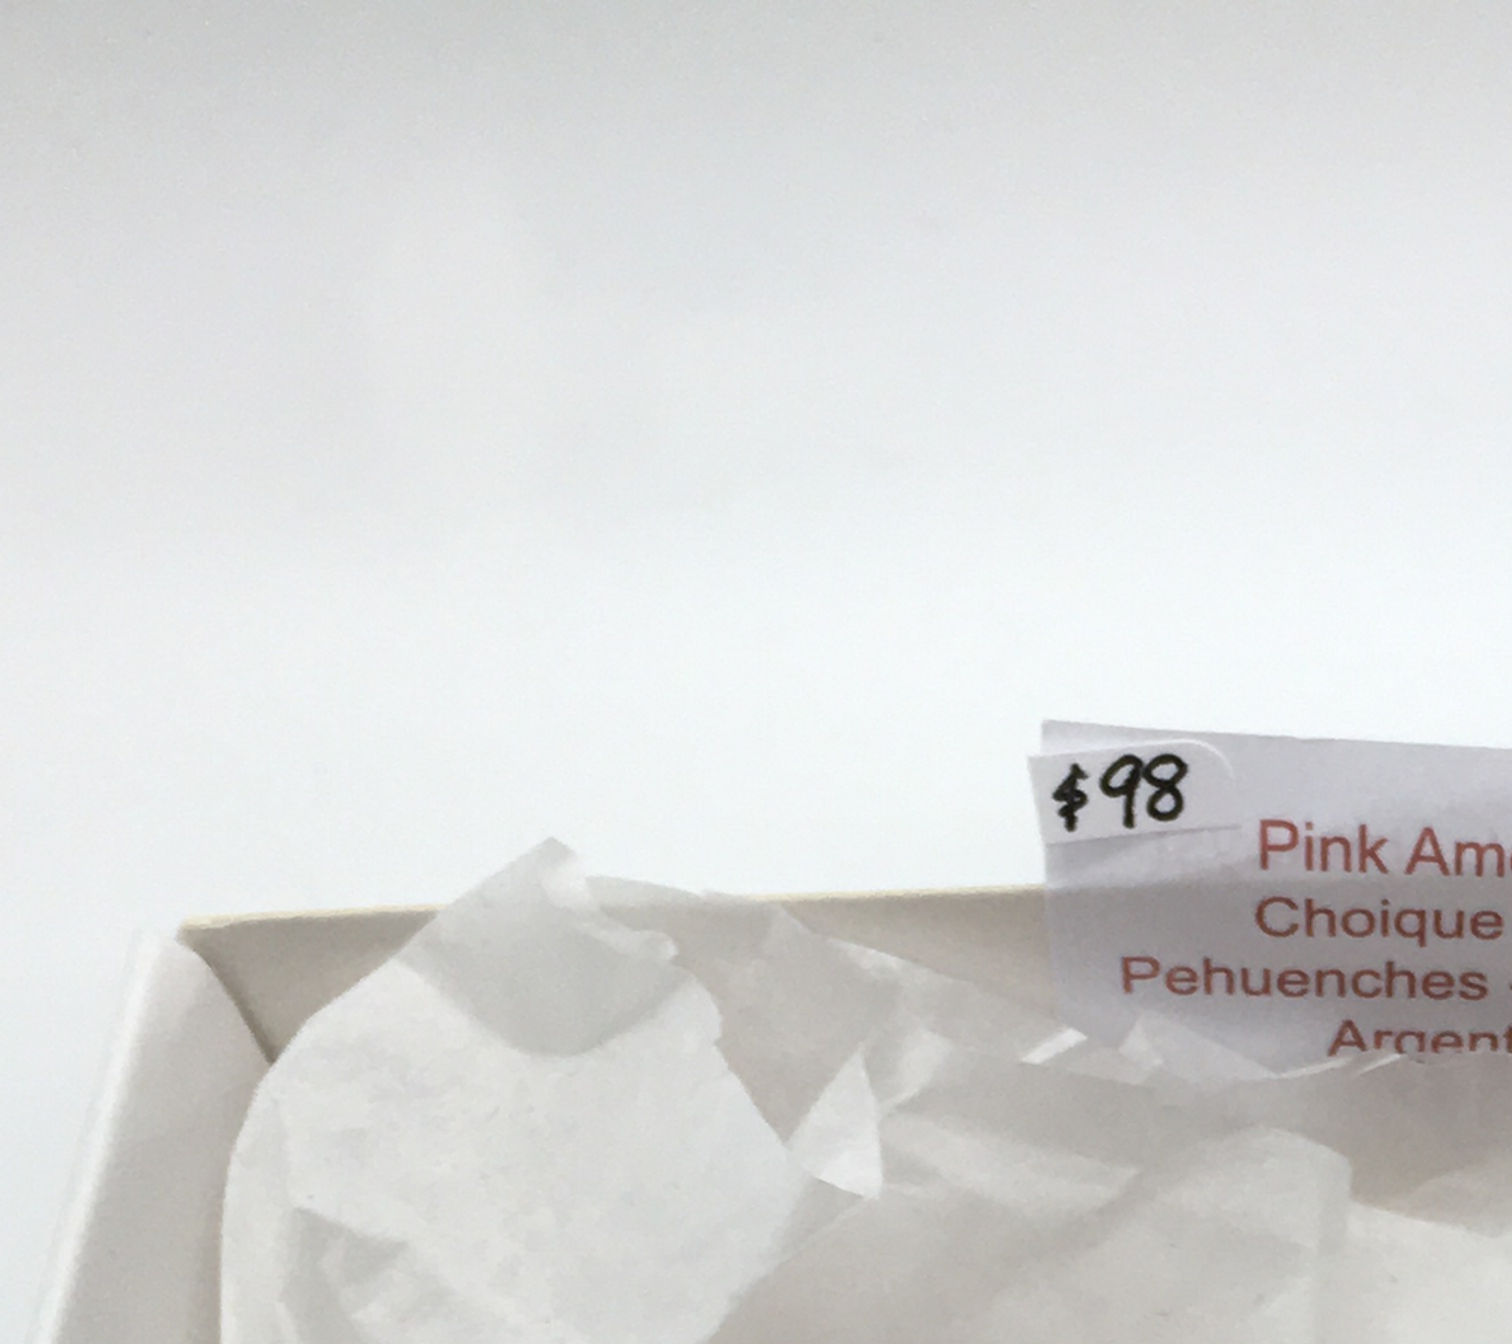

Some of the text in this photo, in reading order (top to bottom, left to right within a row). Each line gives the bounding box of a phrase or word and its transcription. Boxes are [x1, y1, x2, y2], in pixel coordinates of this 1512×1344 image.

[1051, 753, 1188, 832] $98
[1258, 818, 1389, 874] Pink
[1255, 895, 1505, 948] Choique
[1121, 956, 1488, 1001] Pehuenches
